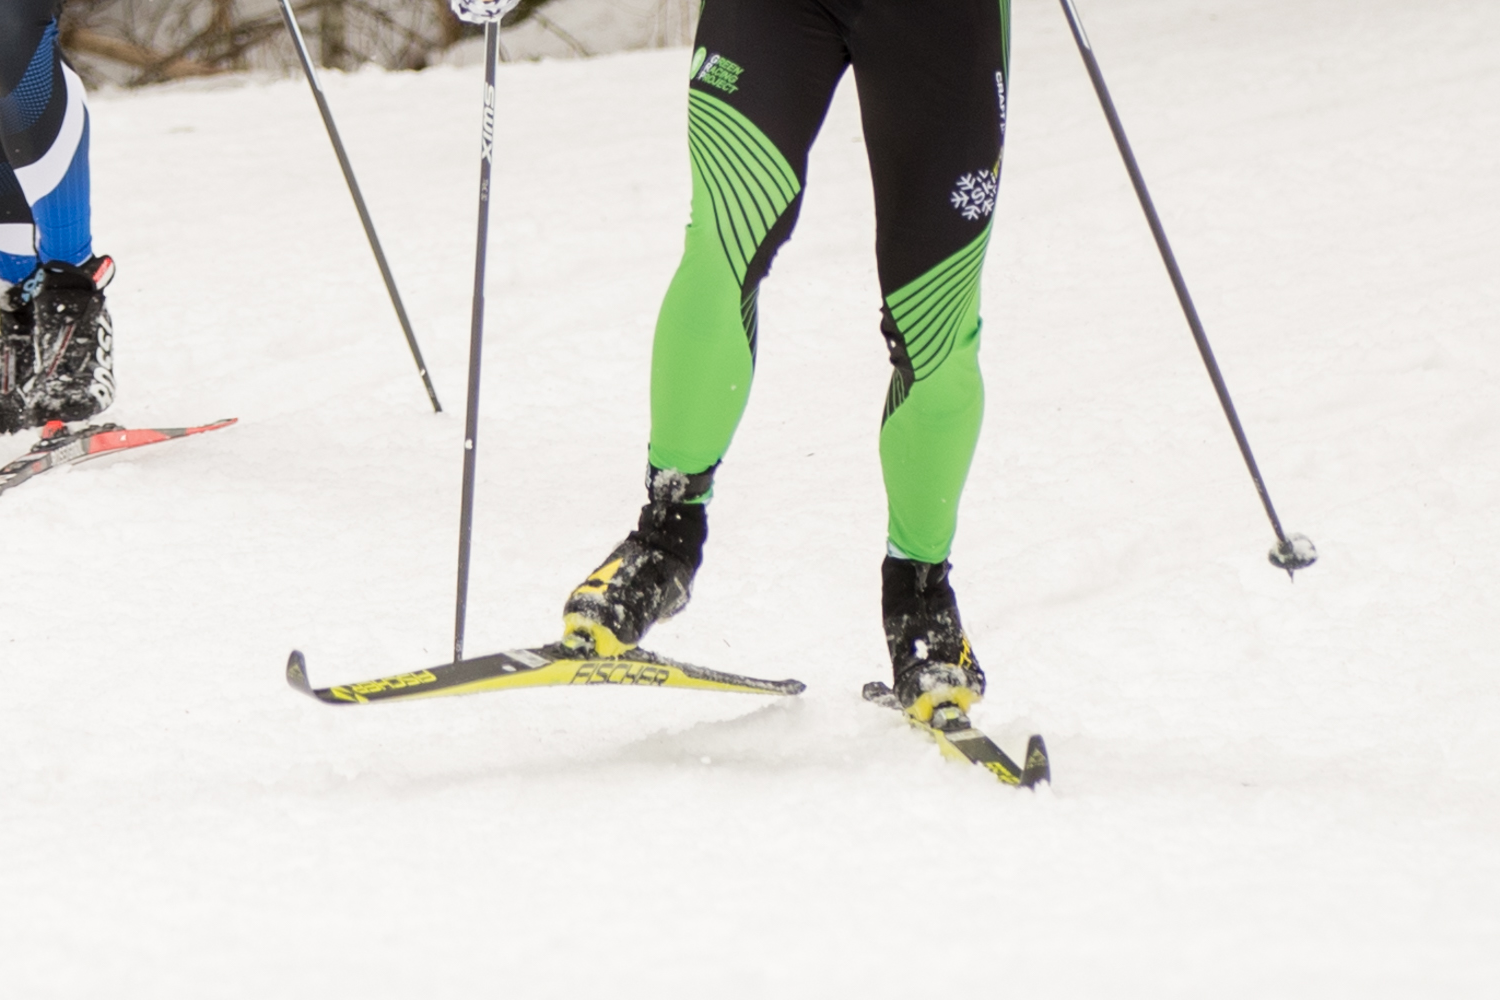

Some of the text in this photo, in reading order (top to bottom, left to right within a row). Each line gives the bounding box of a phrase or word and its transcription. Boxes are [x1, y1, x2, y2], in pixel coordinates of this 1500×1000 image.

[704, 62, 739, 84] RACING
[710, 54, 745, 76] GREEN
[698, 71, 739, 94] PROJECT
[480, 81, 496, 165] SWIX
[353, 669, 437, 695] FISCHER
[569, 662, 671, 687] FISCHER
